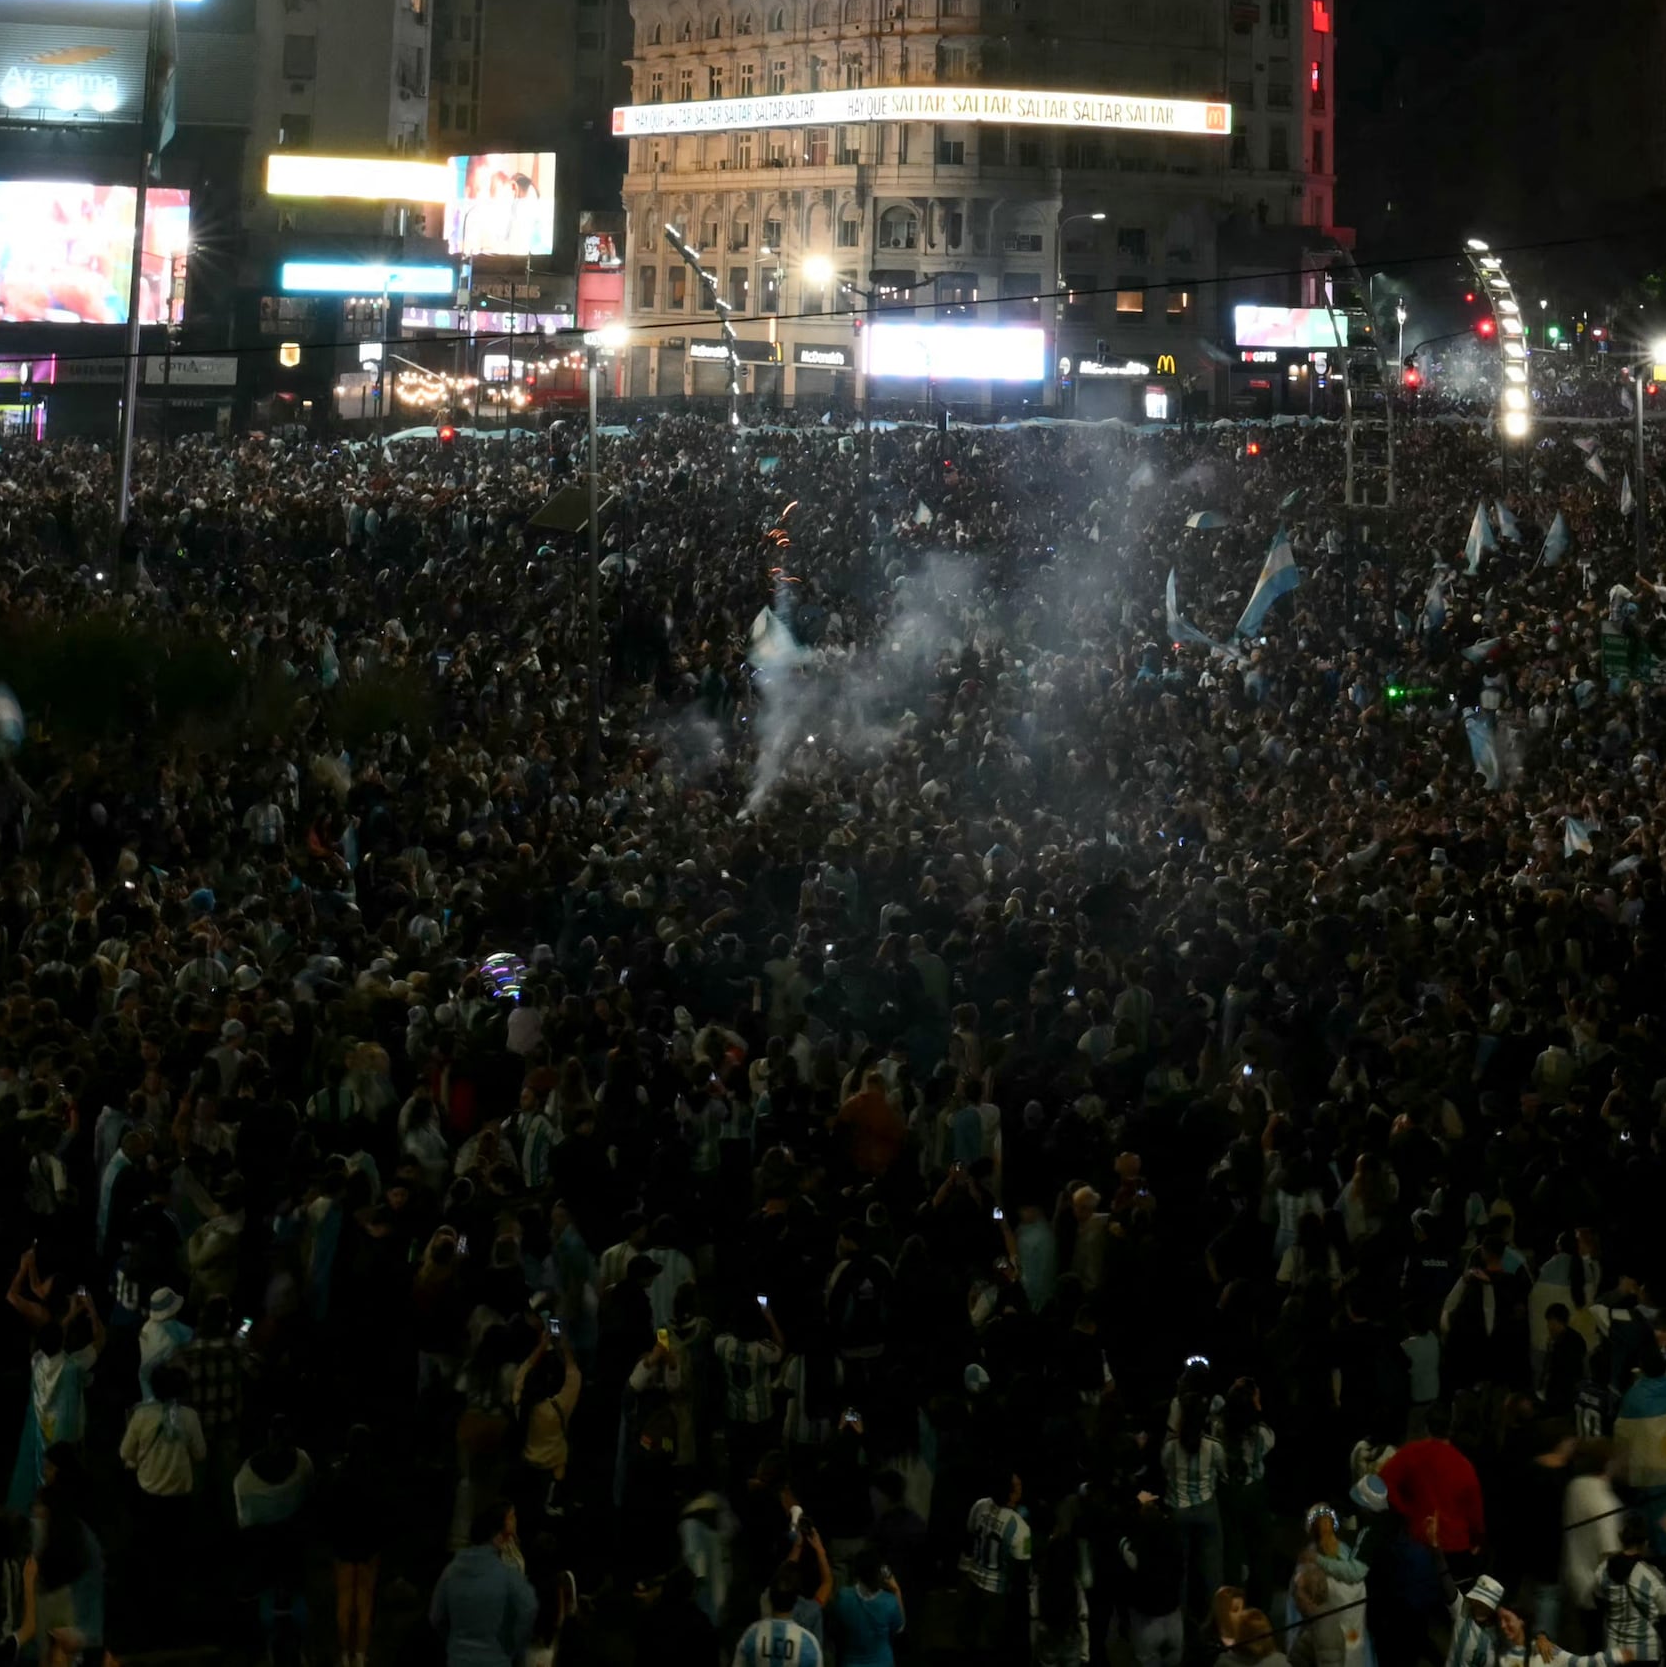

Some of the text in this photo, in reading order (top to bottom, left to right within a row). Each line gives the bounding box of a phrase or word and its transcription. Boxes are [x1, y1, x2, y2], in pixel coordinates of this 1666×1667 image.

[2, 66, 118, 93] Atacama
[694, 106, 722, 125] SALTAR
[724, 104, 753, 124] SALTAR
[755, 101, 784, 122] SALTAR
[785, 99, 816, 119] SALTAR
[848, 99, 866, 116] HAY
[867, 96, 887, 117] QUE
[1018, 98, 1068, 119] SALTAR
[1073, 100, 1123, 124] SALTAR
[801, 350, 845, 365] McDonald's
[116, 1269, 139, 1312] 10
[762, 1635, 795, 1660] LEO
